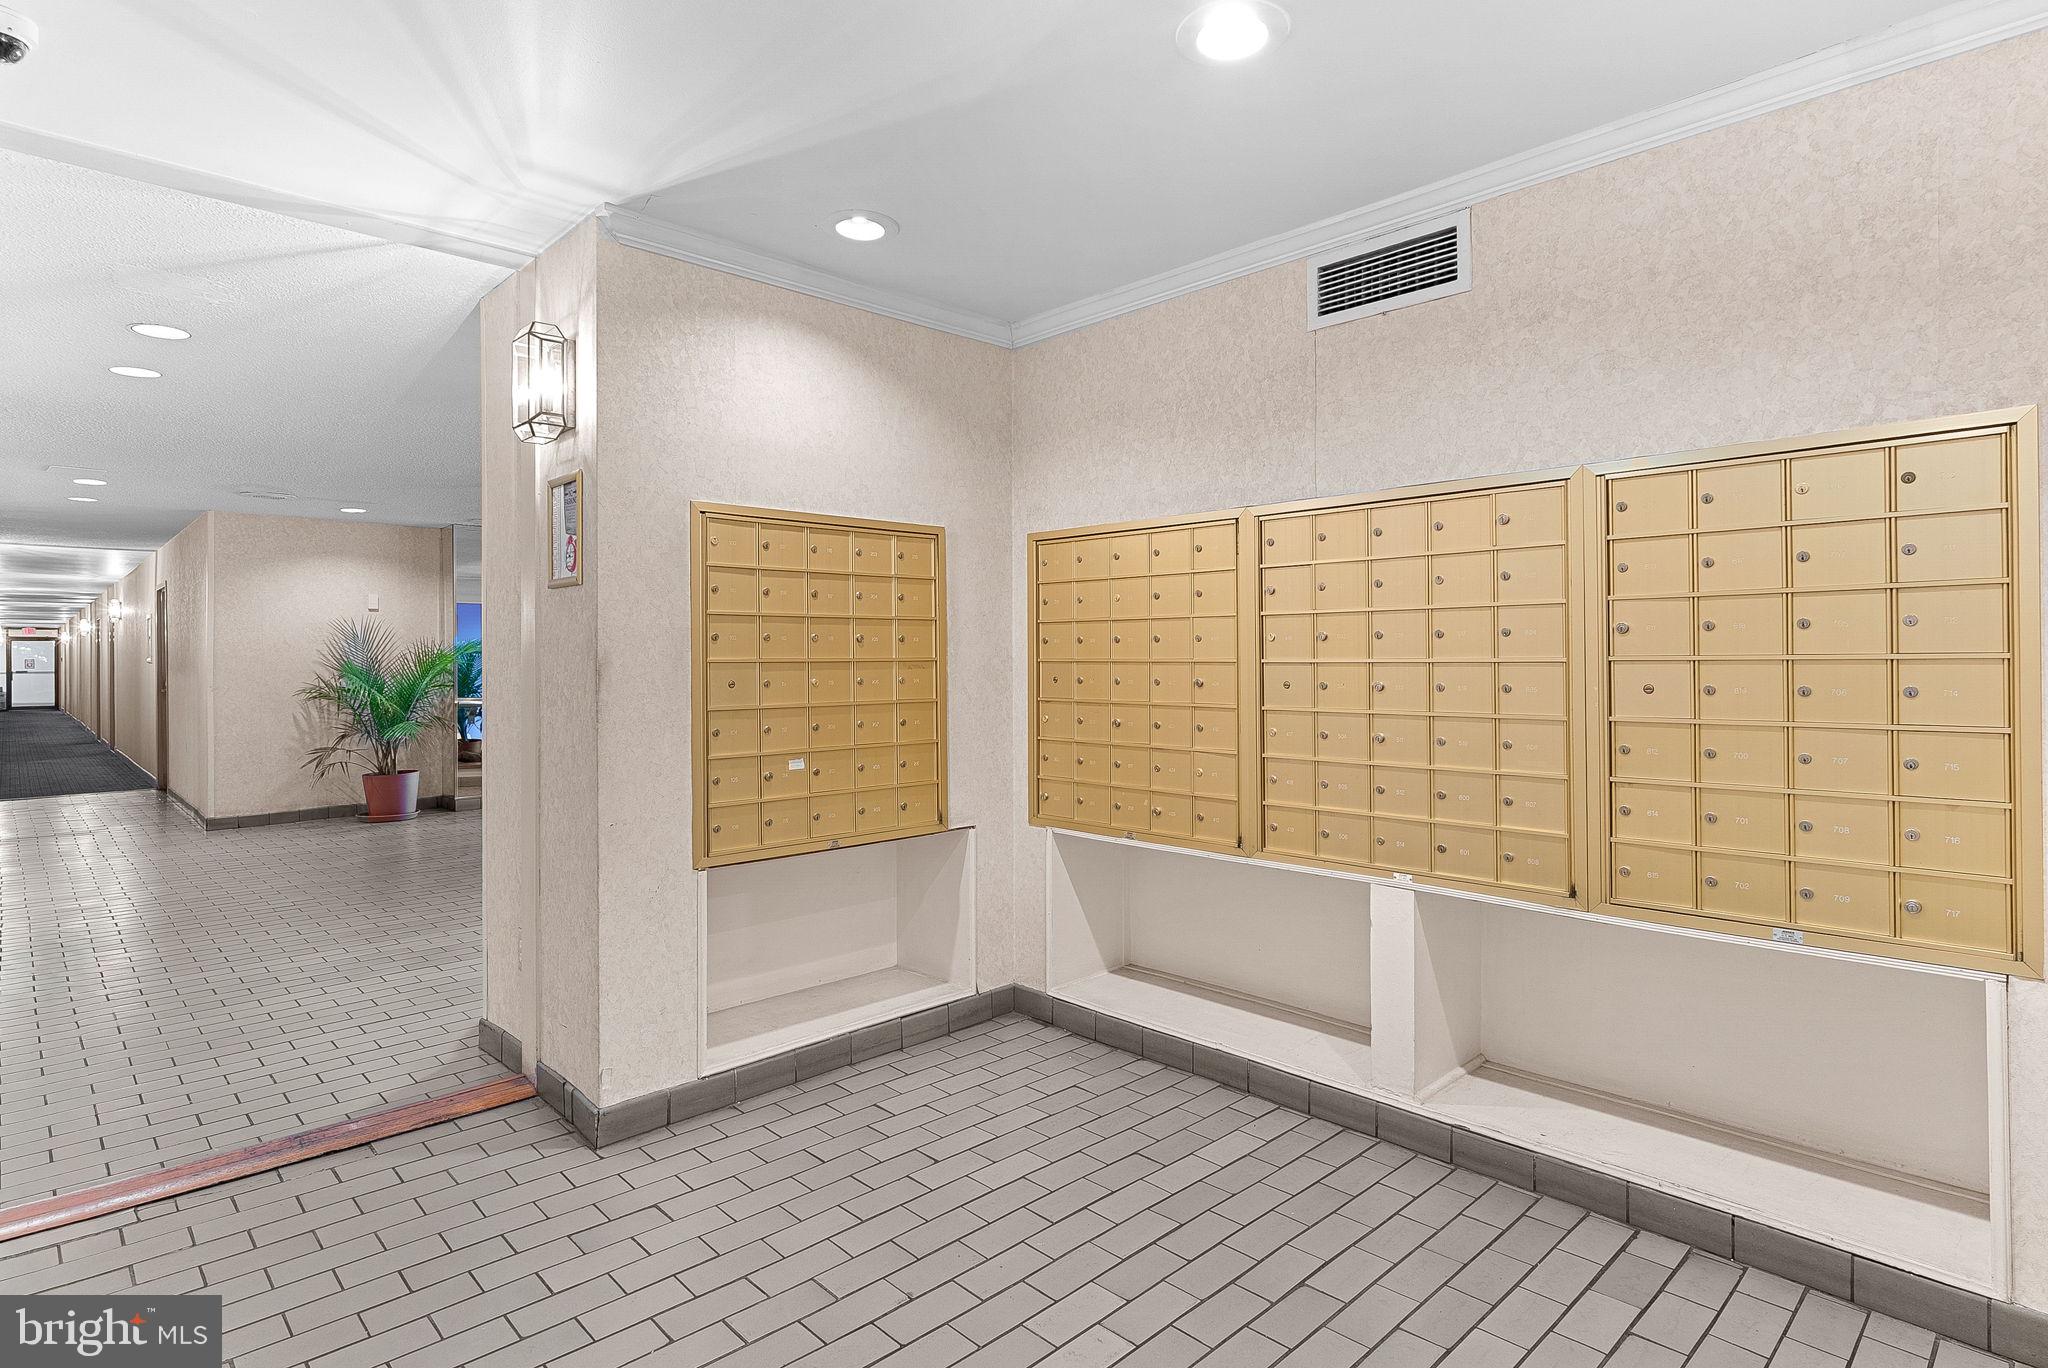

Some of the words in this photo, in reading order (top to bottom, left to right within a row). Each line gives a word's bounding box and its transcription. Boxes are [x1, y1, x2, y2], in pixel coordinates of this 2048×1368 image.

[1831, 689, 1848, 697] 706
[1734, 752, 1749, 760] 700
[1832, 757, 1849, 765] 707
[1944, 763, 1960, 772] 715
[1833, 826, 1850, 834] 708
[1945, 836, 1961, 845] 716
[1735, 881, 1750, 890] 702
[1833, 895, 1851, 903] 709
[1945, 909, 1961, 917] 717
